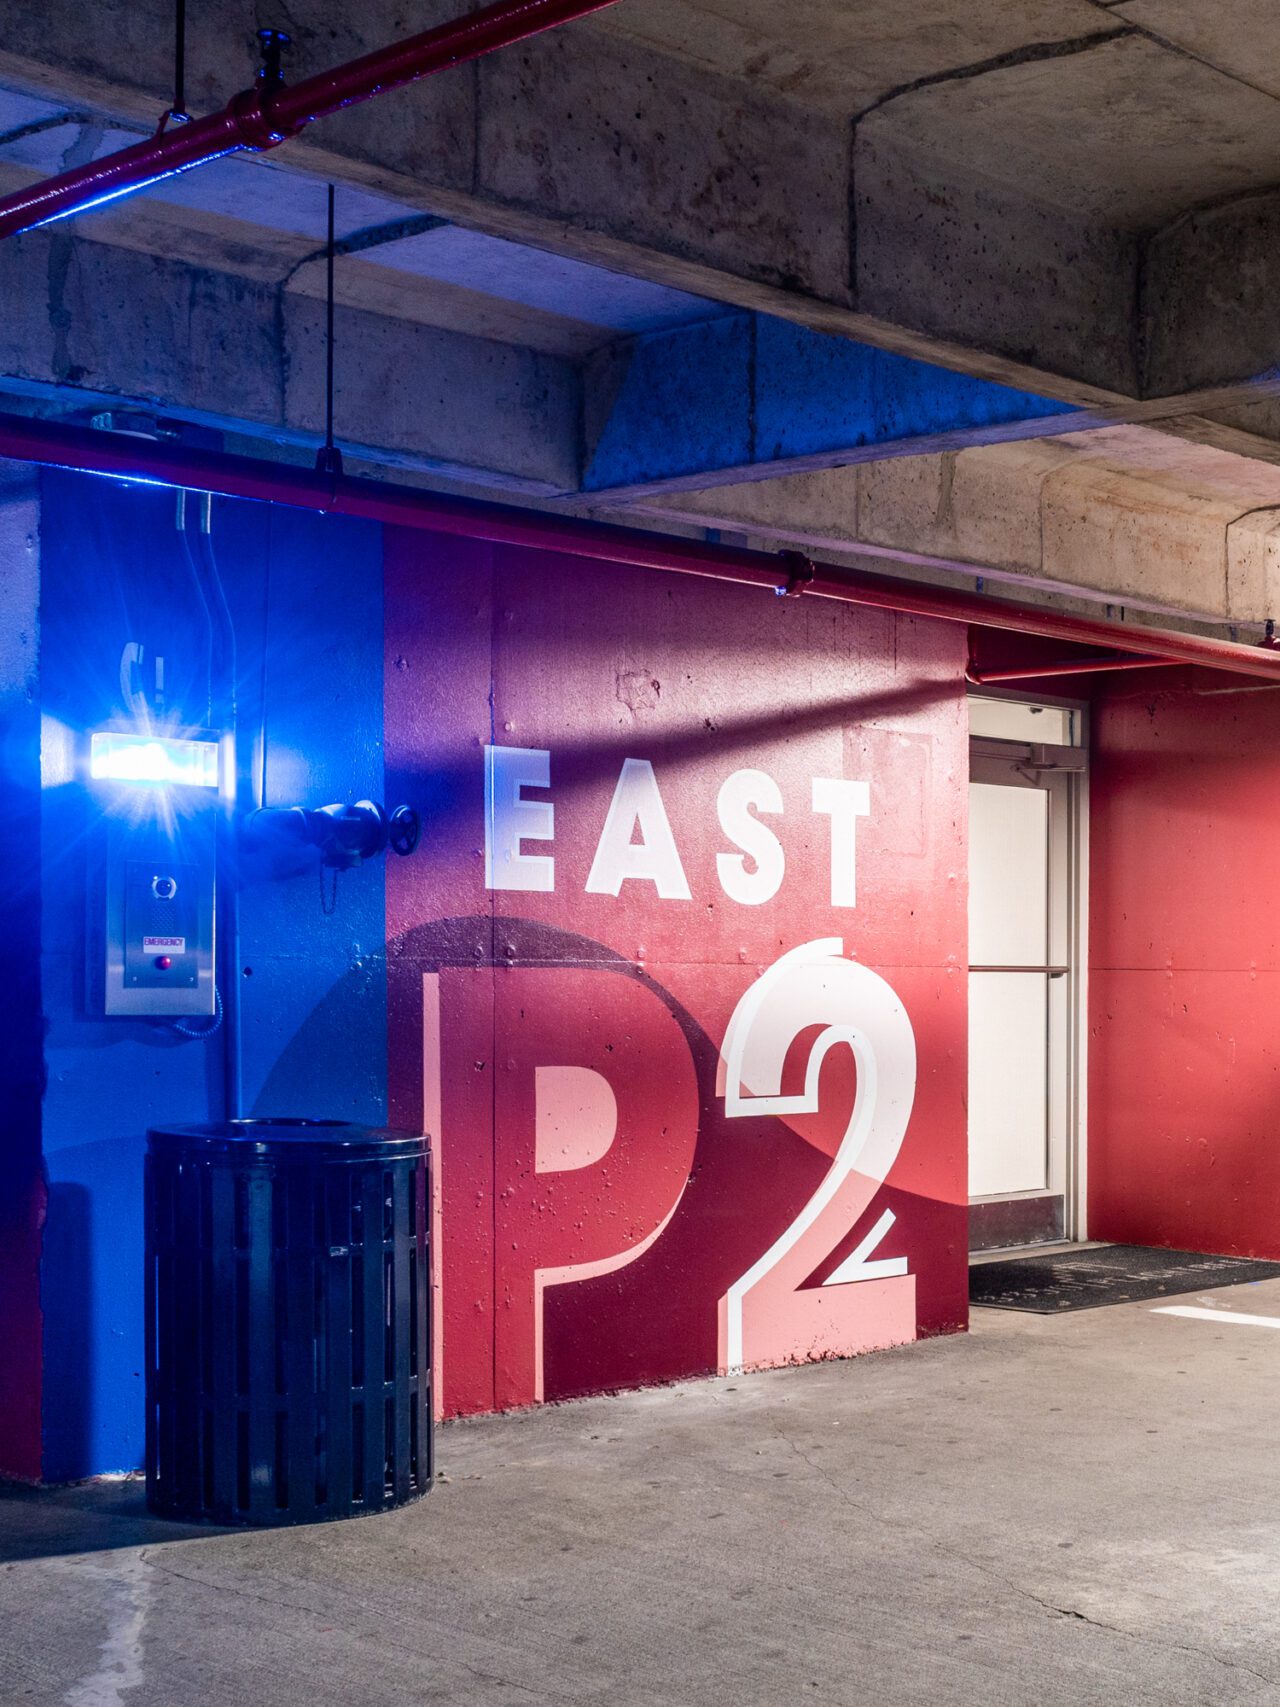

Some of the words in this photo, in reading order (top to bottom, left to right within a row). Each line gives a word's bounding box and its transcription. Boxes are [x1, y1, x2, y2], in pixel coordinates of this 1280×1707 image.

[484, 745, 871, 907] EAST
[144, 937, 183, 946] EMERGENCY
[423, 937, 917, 1422] P2
